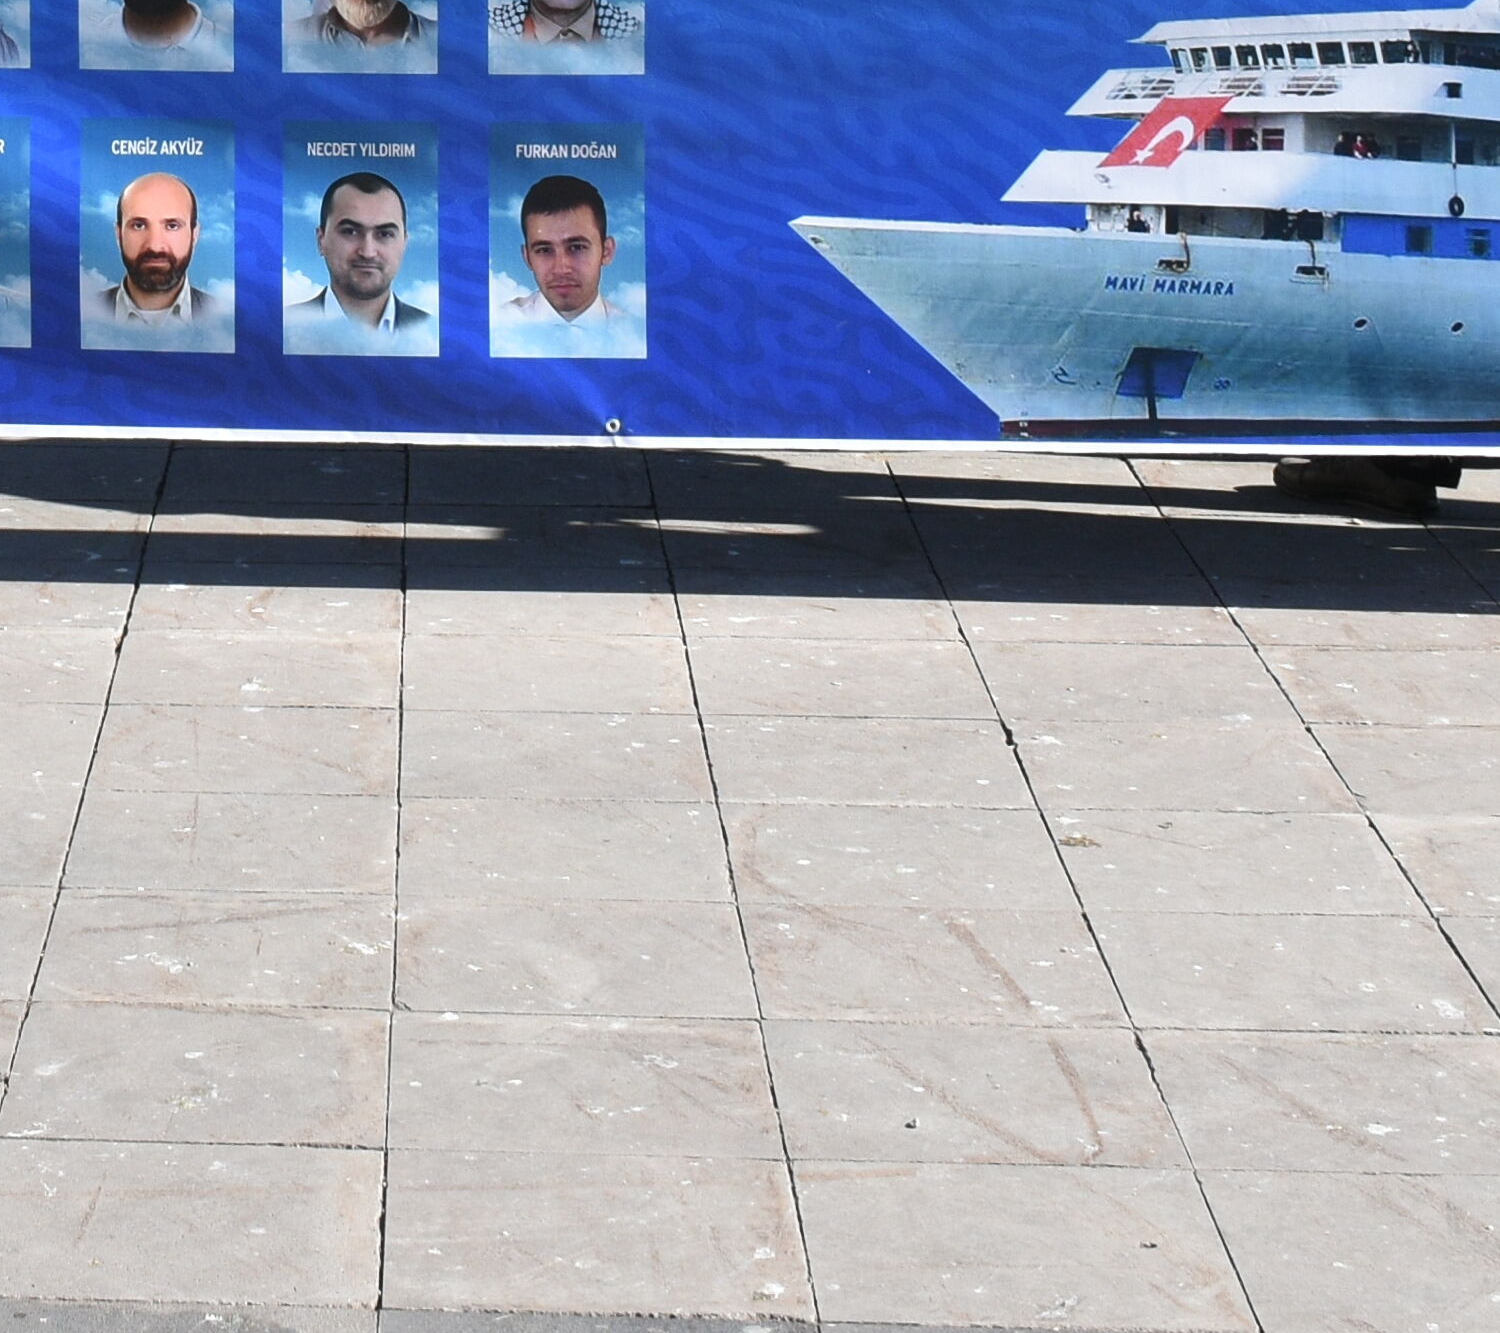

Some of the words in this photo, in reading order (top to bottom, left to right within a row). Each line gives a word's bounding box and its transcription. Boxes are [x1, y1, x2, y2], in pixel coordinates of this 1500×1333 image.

[111, 136, 158, 156] CENGİZ
[159, 137, 204, 156] AKYÜZ
[306, 141, 358, 158] NECDET
[358, 142, 416, 159] YILDIRIM
[515, 143, 569, 160] FURKAN
[570, 140, 618, 160] DOĞAN
[1104, 274, 1147, 292] MAVİ
[1152, 278, 1235, 296] MARMARA
